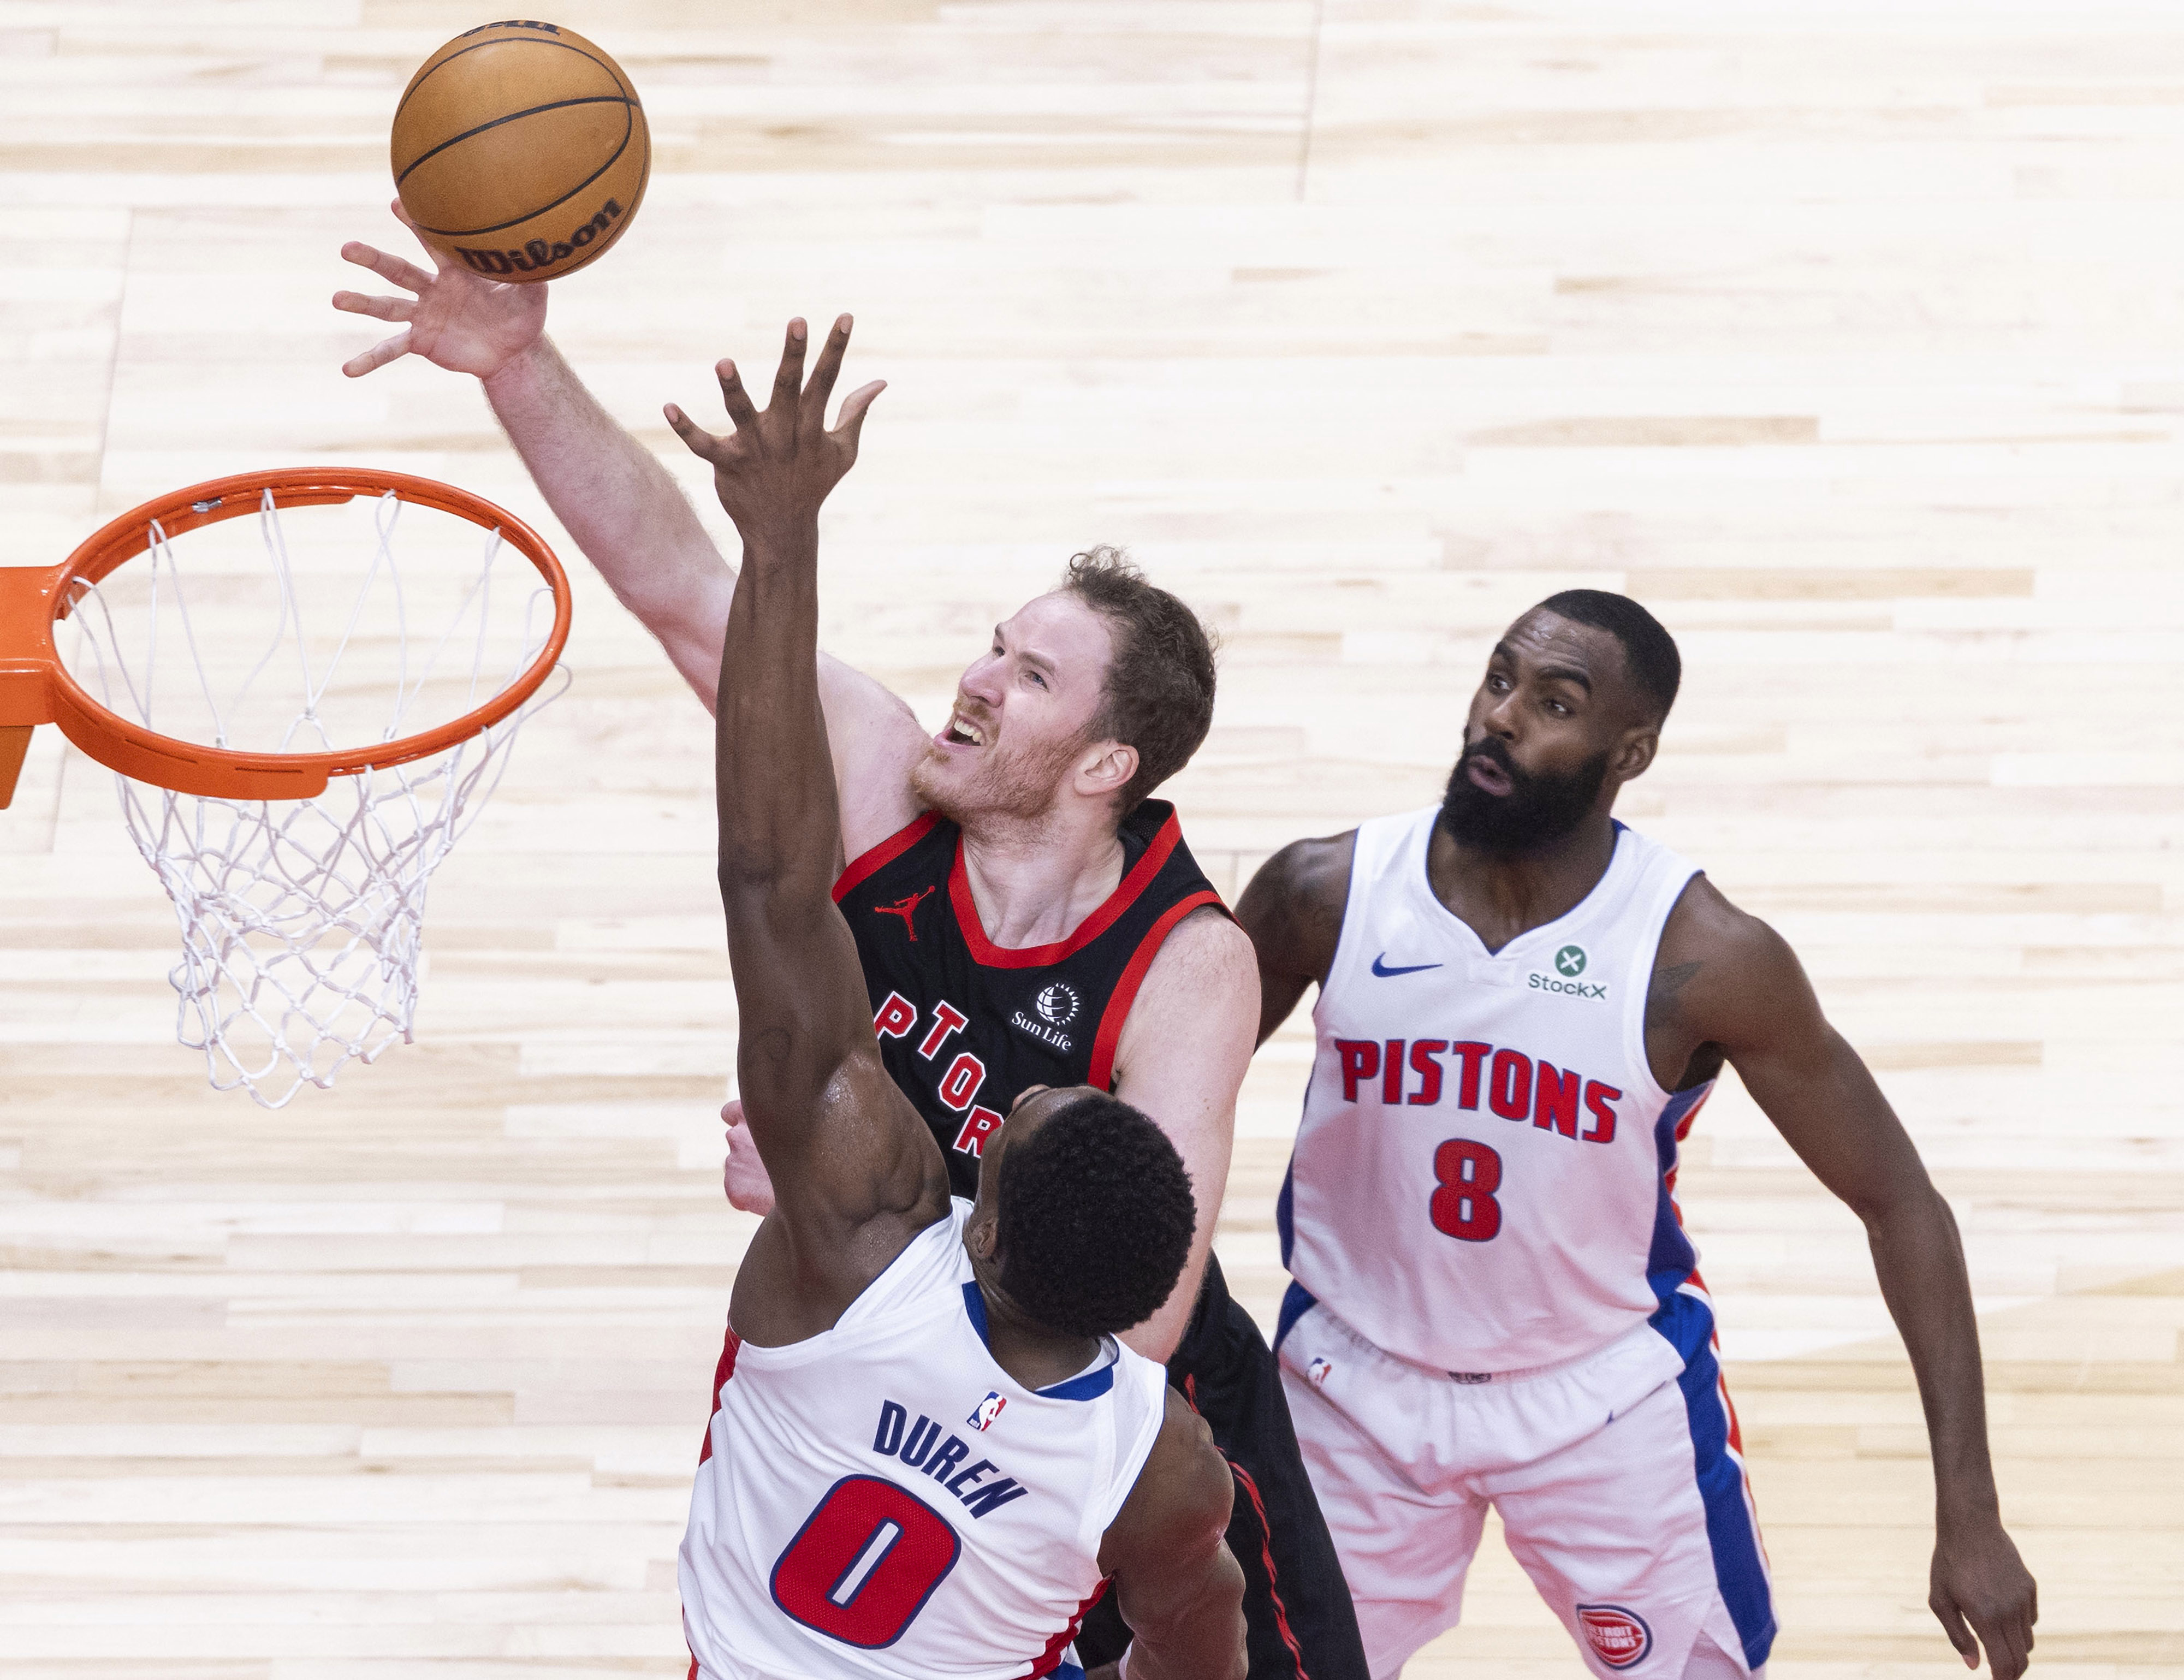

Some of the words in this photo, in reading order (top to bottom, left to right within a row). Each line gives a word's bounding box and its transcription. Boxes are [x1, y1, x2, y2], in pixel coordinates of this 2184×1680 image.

[454, 197, 624, 275] Wilson
[1012, 1011, 1042, 1036] Sun
[1042, 1026, 1072, 1051] Life
[1528, 973, 1607, 1000] StockX
[874, 990, 1005, 1159] PTOR
[1334, 1038, 1623, 1144] PISTONS
[1429, 1138, 1503, 1242] 8
[873, 1399, 1029, 1520] DUREN
[769, 1473, 962, 1651] 0
